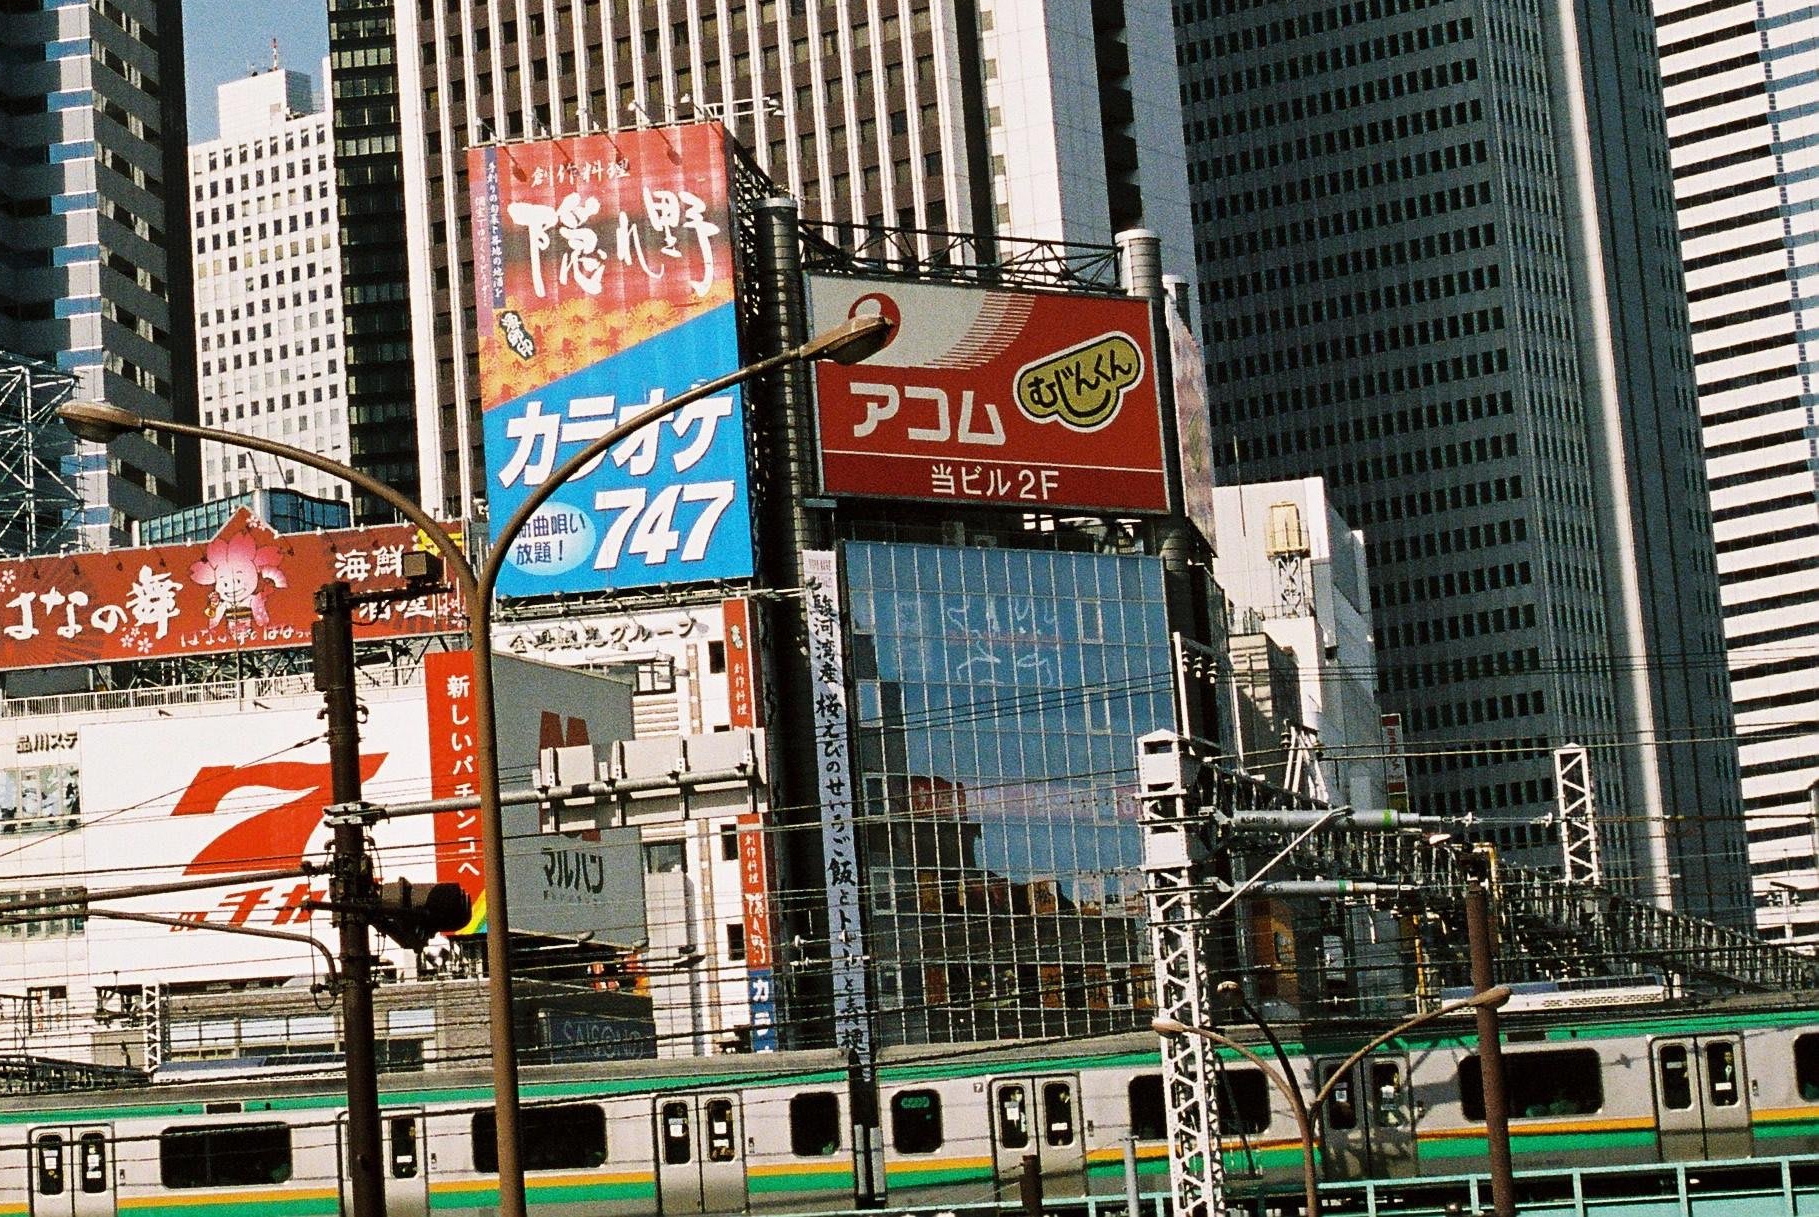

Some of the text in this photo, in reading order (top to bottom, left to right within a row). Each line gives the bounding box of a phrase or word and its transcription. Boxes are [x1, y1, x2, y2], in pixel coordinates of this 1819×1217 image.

[531, 158, 631, 187] 創作料理
[507, 186, 720, 298] 隠れ野
[848, 381, 1007, 446] アコム
[1027, 348, 1134, 418] むじんくん
[498, 388, 735, 489] カラオケ
[593, 479, 735, 571] 747
[334, 543, 405, 583] 海鮮
[16, 730, 79, 754] 品川ステ
[446, 674, 481, 877] 新しいパチンコへ
